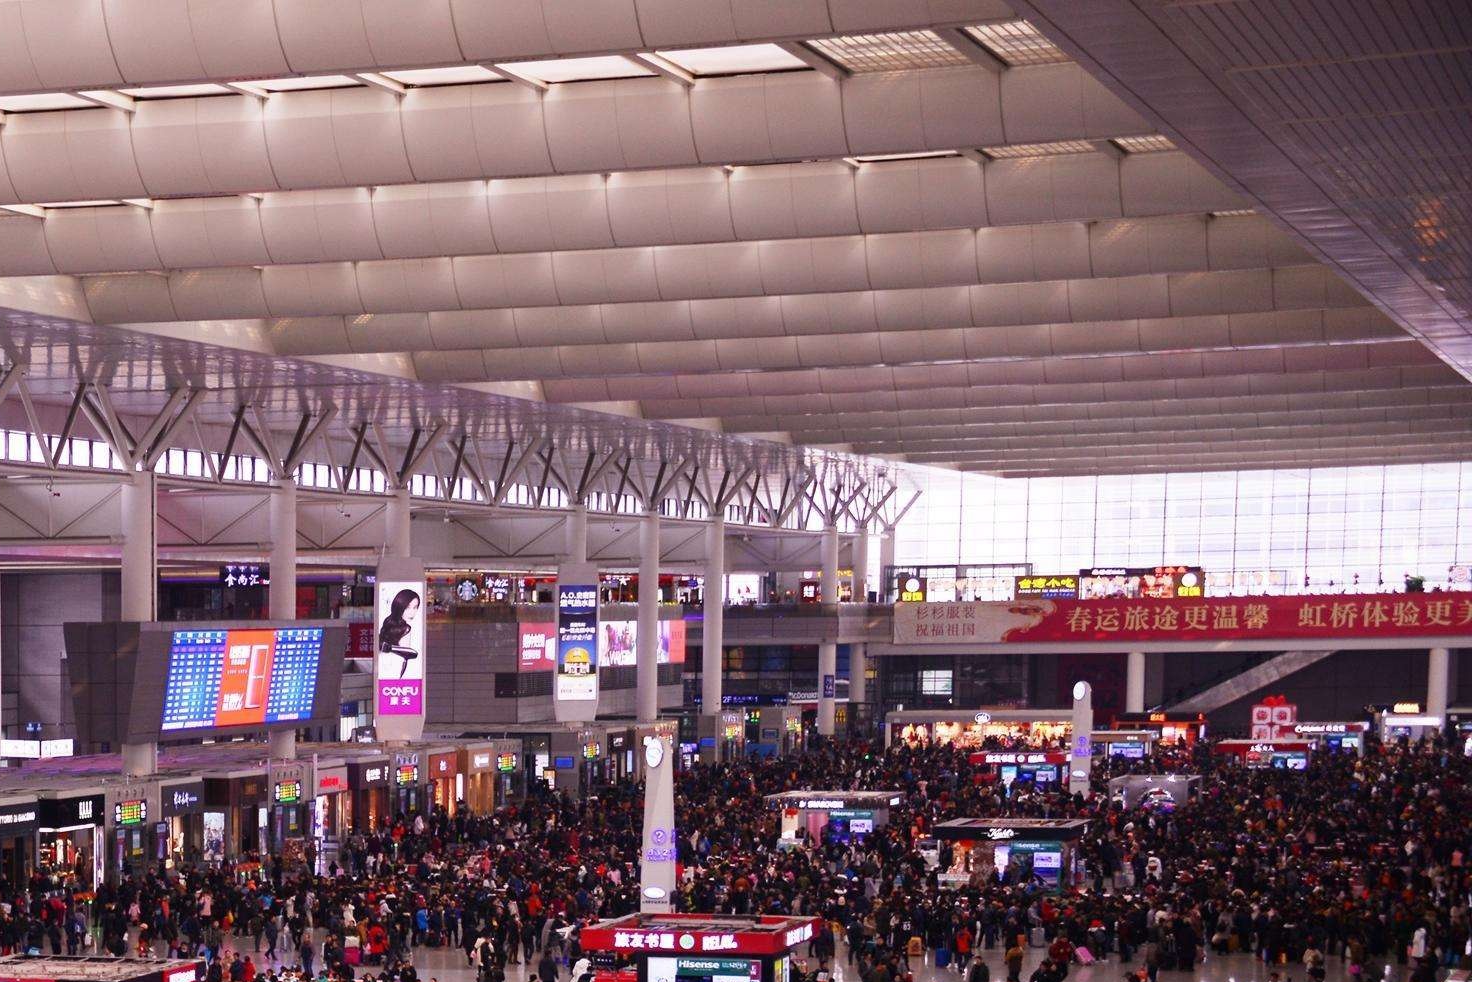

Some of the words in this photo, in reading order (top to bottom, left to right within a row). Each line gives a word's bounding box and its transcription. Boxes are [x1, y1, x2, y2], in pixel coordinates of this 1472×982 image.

[916, 605, 976, 621] 杉杉服装
[1065, 604, 1270, 632] 春运旅途更温馨
[915, 622, 976, 637] 祝福祖国
[382, 686, 419, 697] CONFU
[678, 960, 720, 970] Hisense
